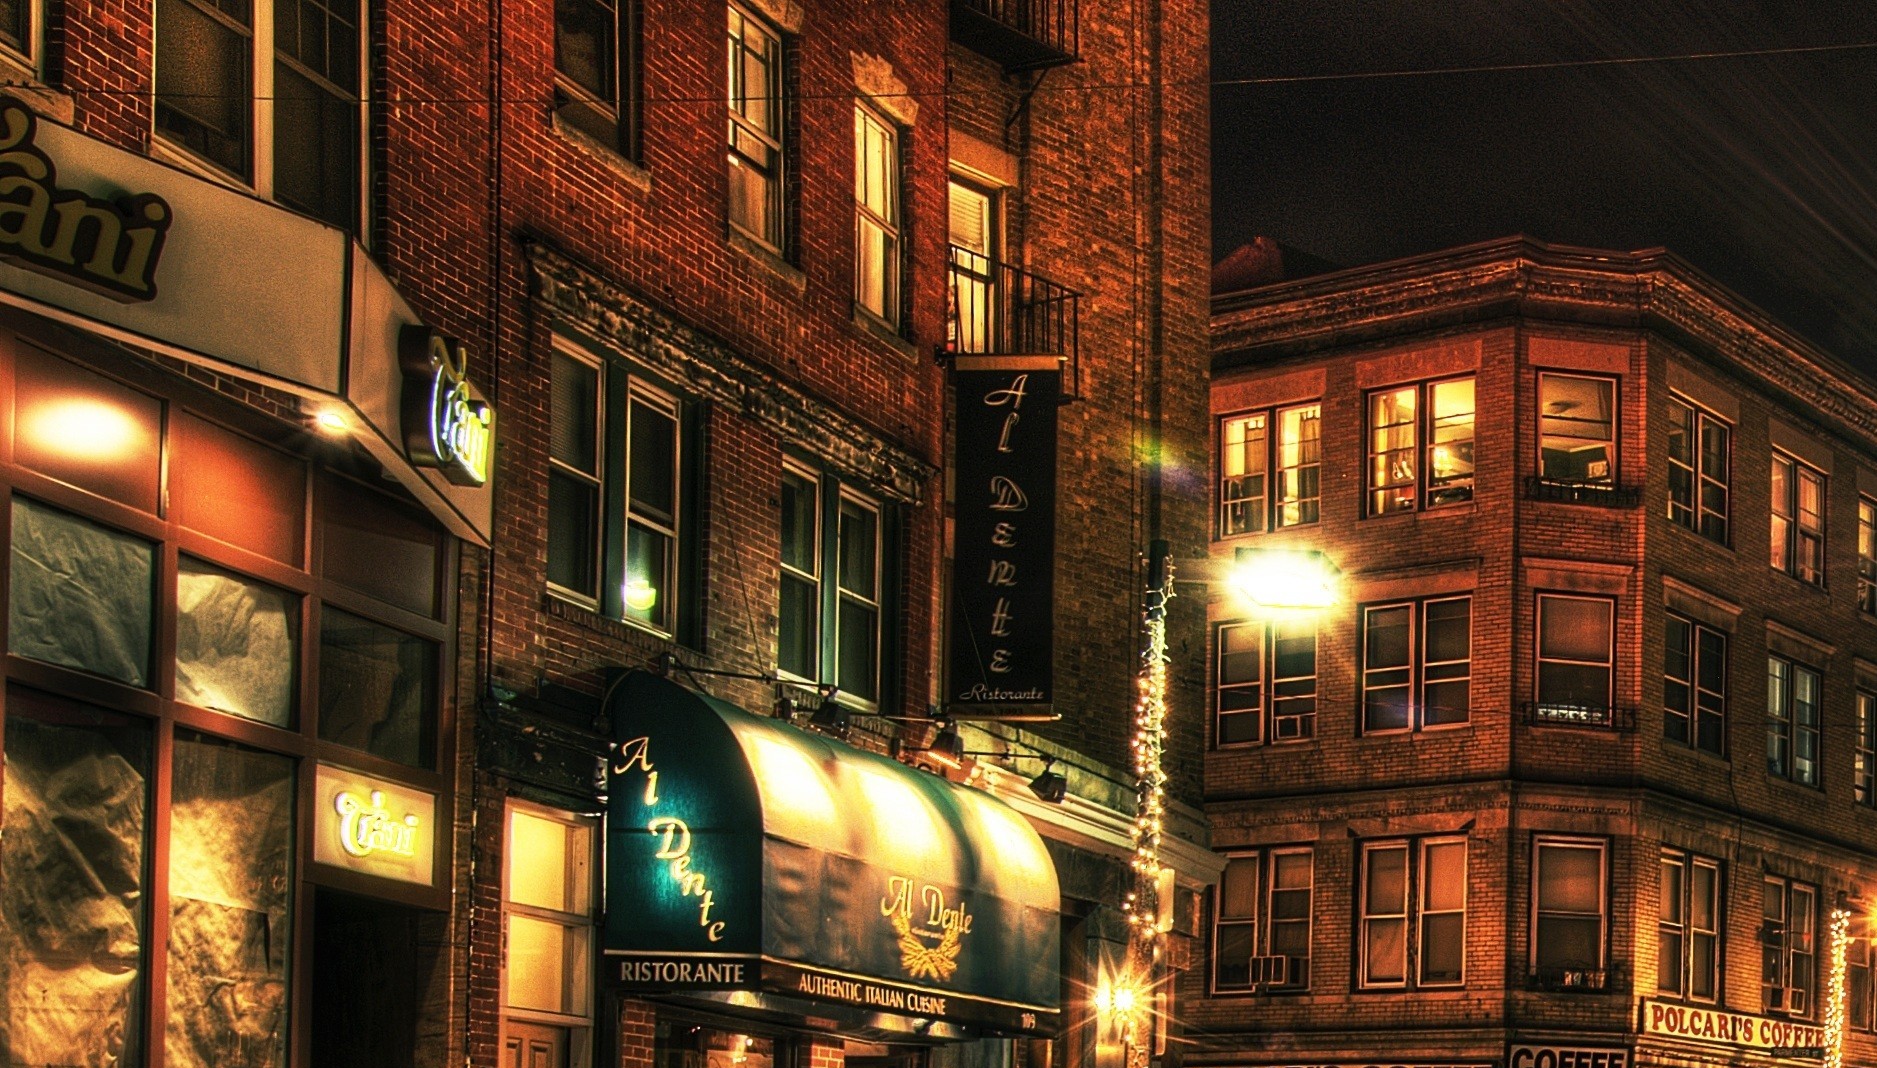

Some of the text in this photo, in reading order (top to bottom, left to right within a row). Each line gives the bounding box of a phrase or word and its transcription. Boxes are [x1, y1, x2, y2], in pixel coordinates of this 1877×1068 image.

[959, 683, 1044, 702] Ristorante
[648, 816, 726, 942] Dente
[881, 875, 973, 934] Al Dente
[621, 961, 744, 983] RISTORANTE
[800, 973, 946, 1015] AUTHENTIC ITALIAN CUISINE
[1651, 1004, 1826, 1048] POLCARI'S COFFEE
